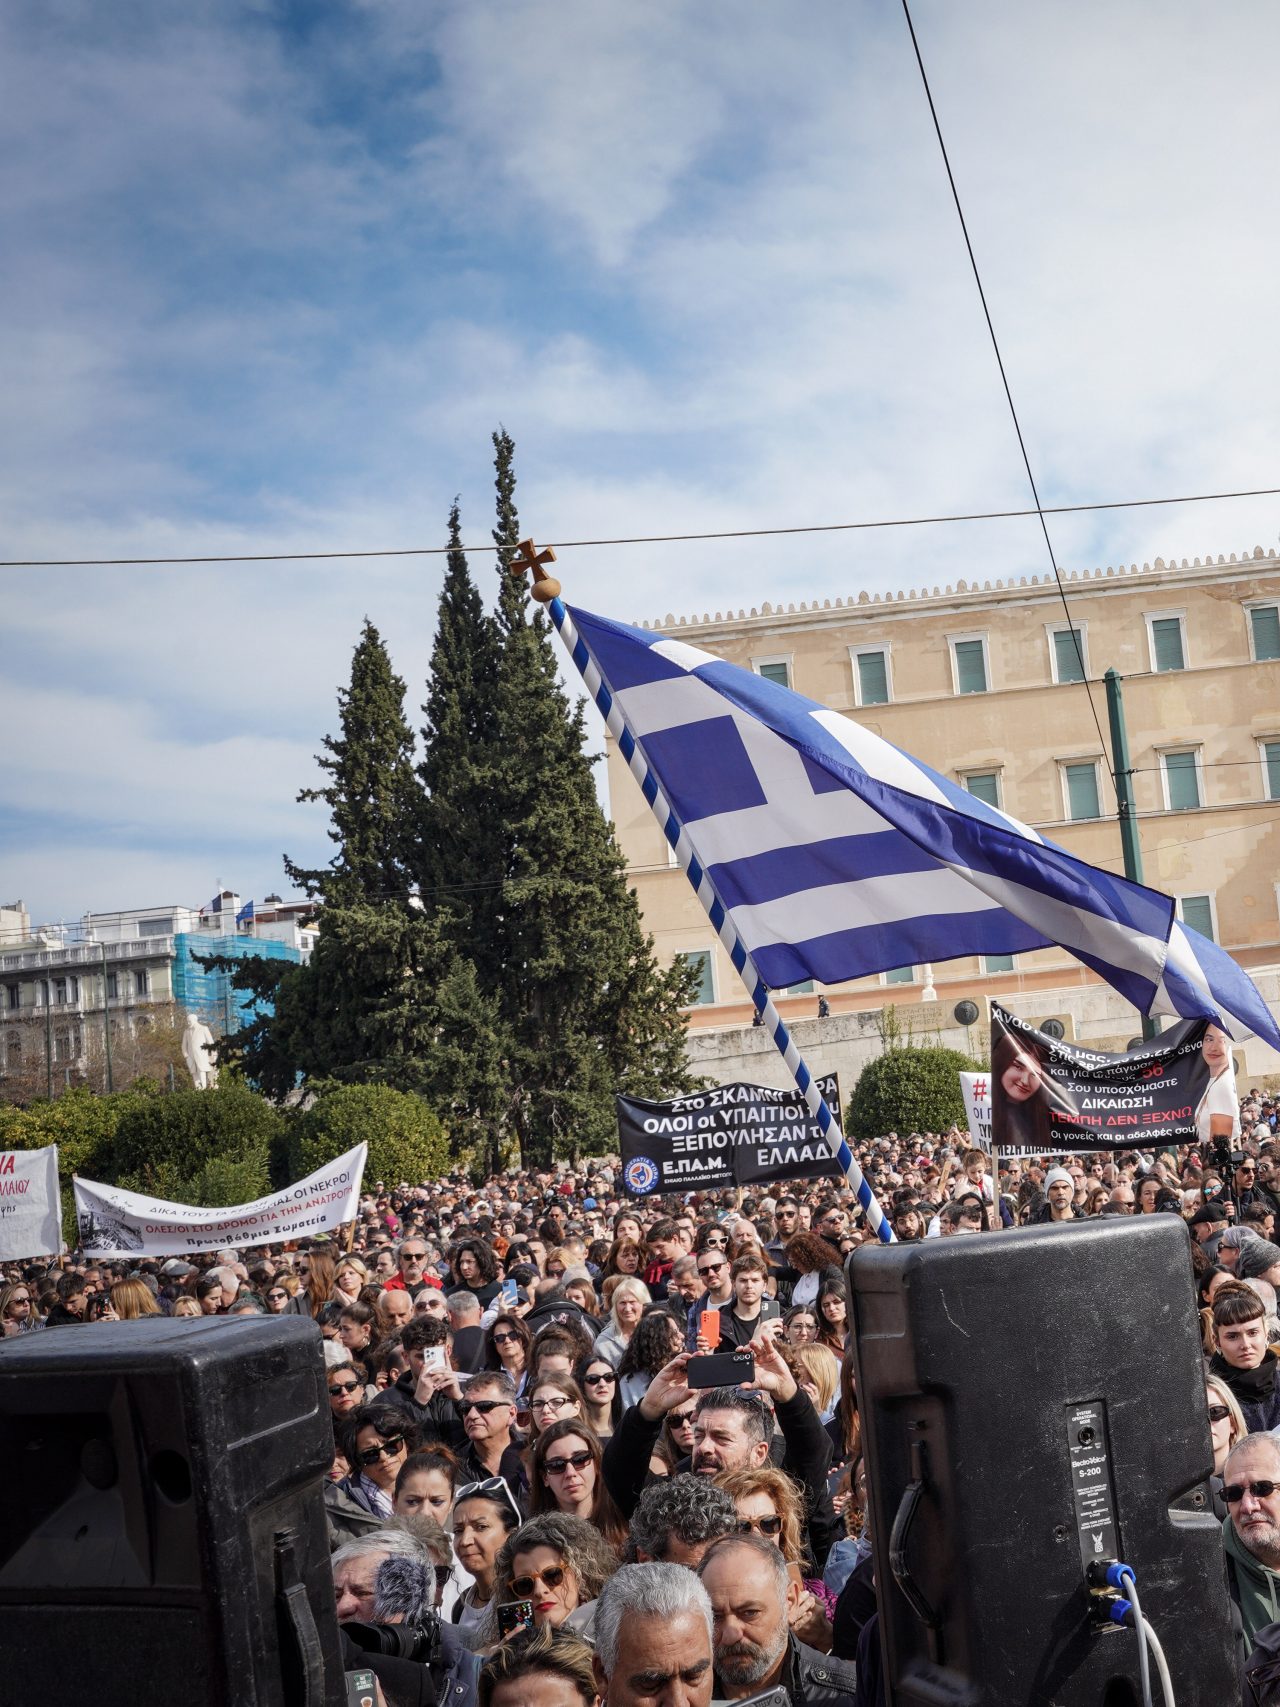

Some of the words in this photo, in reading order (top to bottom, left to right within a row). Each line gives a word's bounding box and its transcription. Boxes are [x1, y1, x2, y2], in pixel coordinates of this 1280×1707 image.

[1050, 1068, 1069, 1077] και
[1067, 1082, 1091, 1093] Σου
[1094, 1077, 1179, 1096] υποσχόμαστε
[671, 1098, 705, 1113] Στο
[1081, 1096, 1154, 1110] ΔΙΚΑΙΩΣΗ
[643, 1115, 693, 1134] ΟΛΟΙ
[697, 1115, 717, 1129] οι
[720, 1104, 804, 1126] ΥΠΑΙΤΙΟΙ
[1050, 1111, 1102, 1126] ΤΕΜΠΗ
[1106, 1115, 1138, 1126] ΔΕΝ
[1142, 1106, 1193, 1124] ΞΕΧΝΩ
[671, 1124, 807, 1153] ΞΕΠΟΥΛΗΣΑΝ
[1050, 1130, 1061, 1140] Οι
[1063, 1129, 1095, 1142] γονείς
[1097, 1131, 1113, 1141] και
[1115, 1132, 1125, 1141] οι
[1127, 1127, 1172, 1141] αδελφές
[1174, 1125, 1196, 1135] σου
[757, 1142, 837, 1166] ΕΛΛΑΔ
[662, 1156, 728, 1175] Ε.ΠΑ.Μ.
[149, 1206, 178, 1217] ΔΙΚΑ
[294, 1188, 308, 1199] ΟΙ
[309, 1171, 350, 1194] ΝΕΚΡΟΙ
[145, 1224, 190, 1234] ΟΛΕΣ/ΟΙ
[191, 1224, 213, 1233] ΣΤΟ
[216, 1216, 258, 1231] ΔΡΟΜΟ
[260, 1212, 279, 1223] ΓΙΑ
[280, 1204, 303, 1217] ΤΗΝ
[304, 1184, 353, 1209] ΑΝΑΤΡΟΠΗ
[186, 1229, 271, 1247] Πρωτοβάθμια
[273, 1213, 327, 1234] Σωματεία
[1078, 1466, 1102, 1478] S-200
